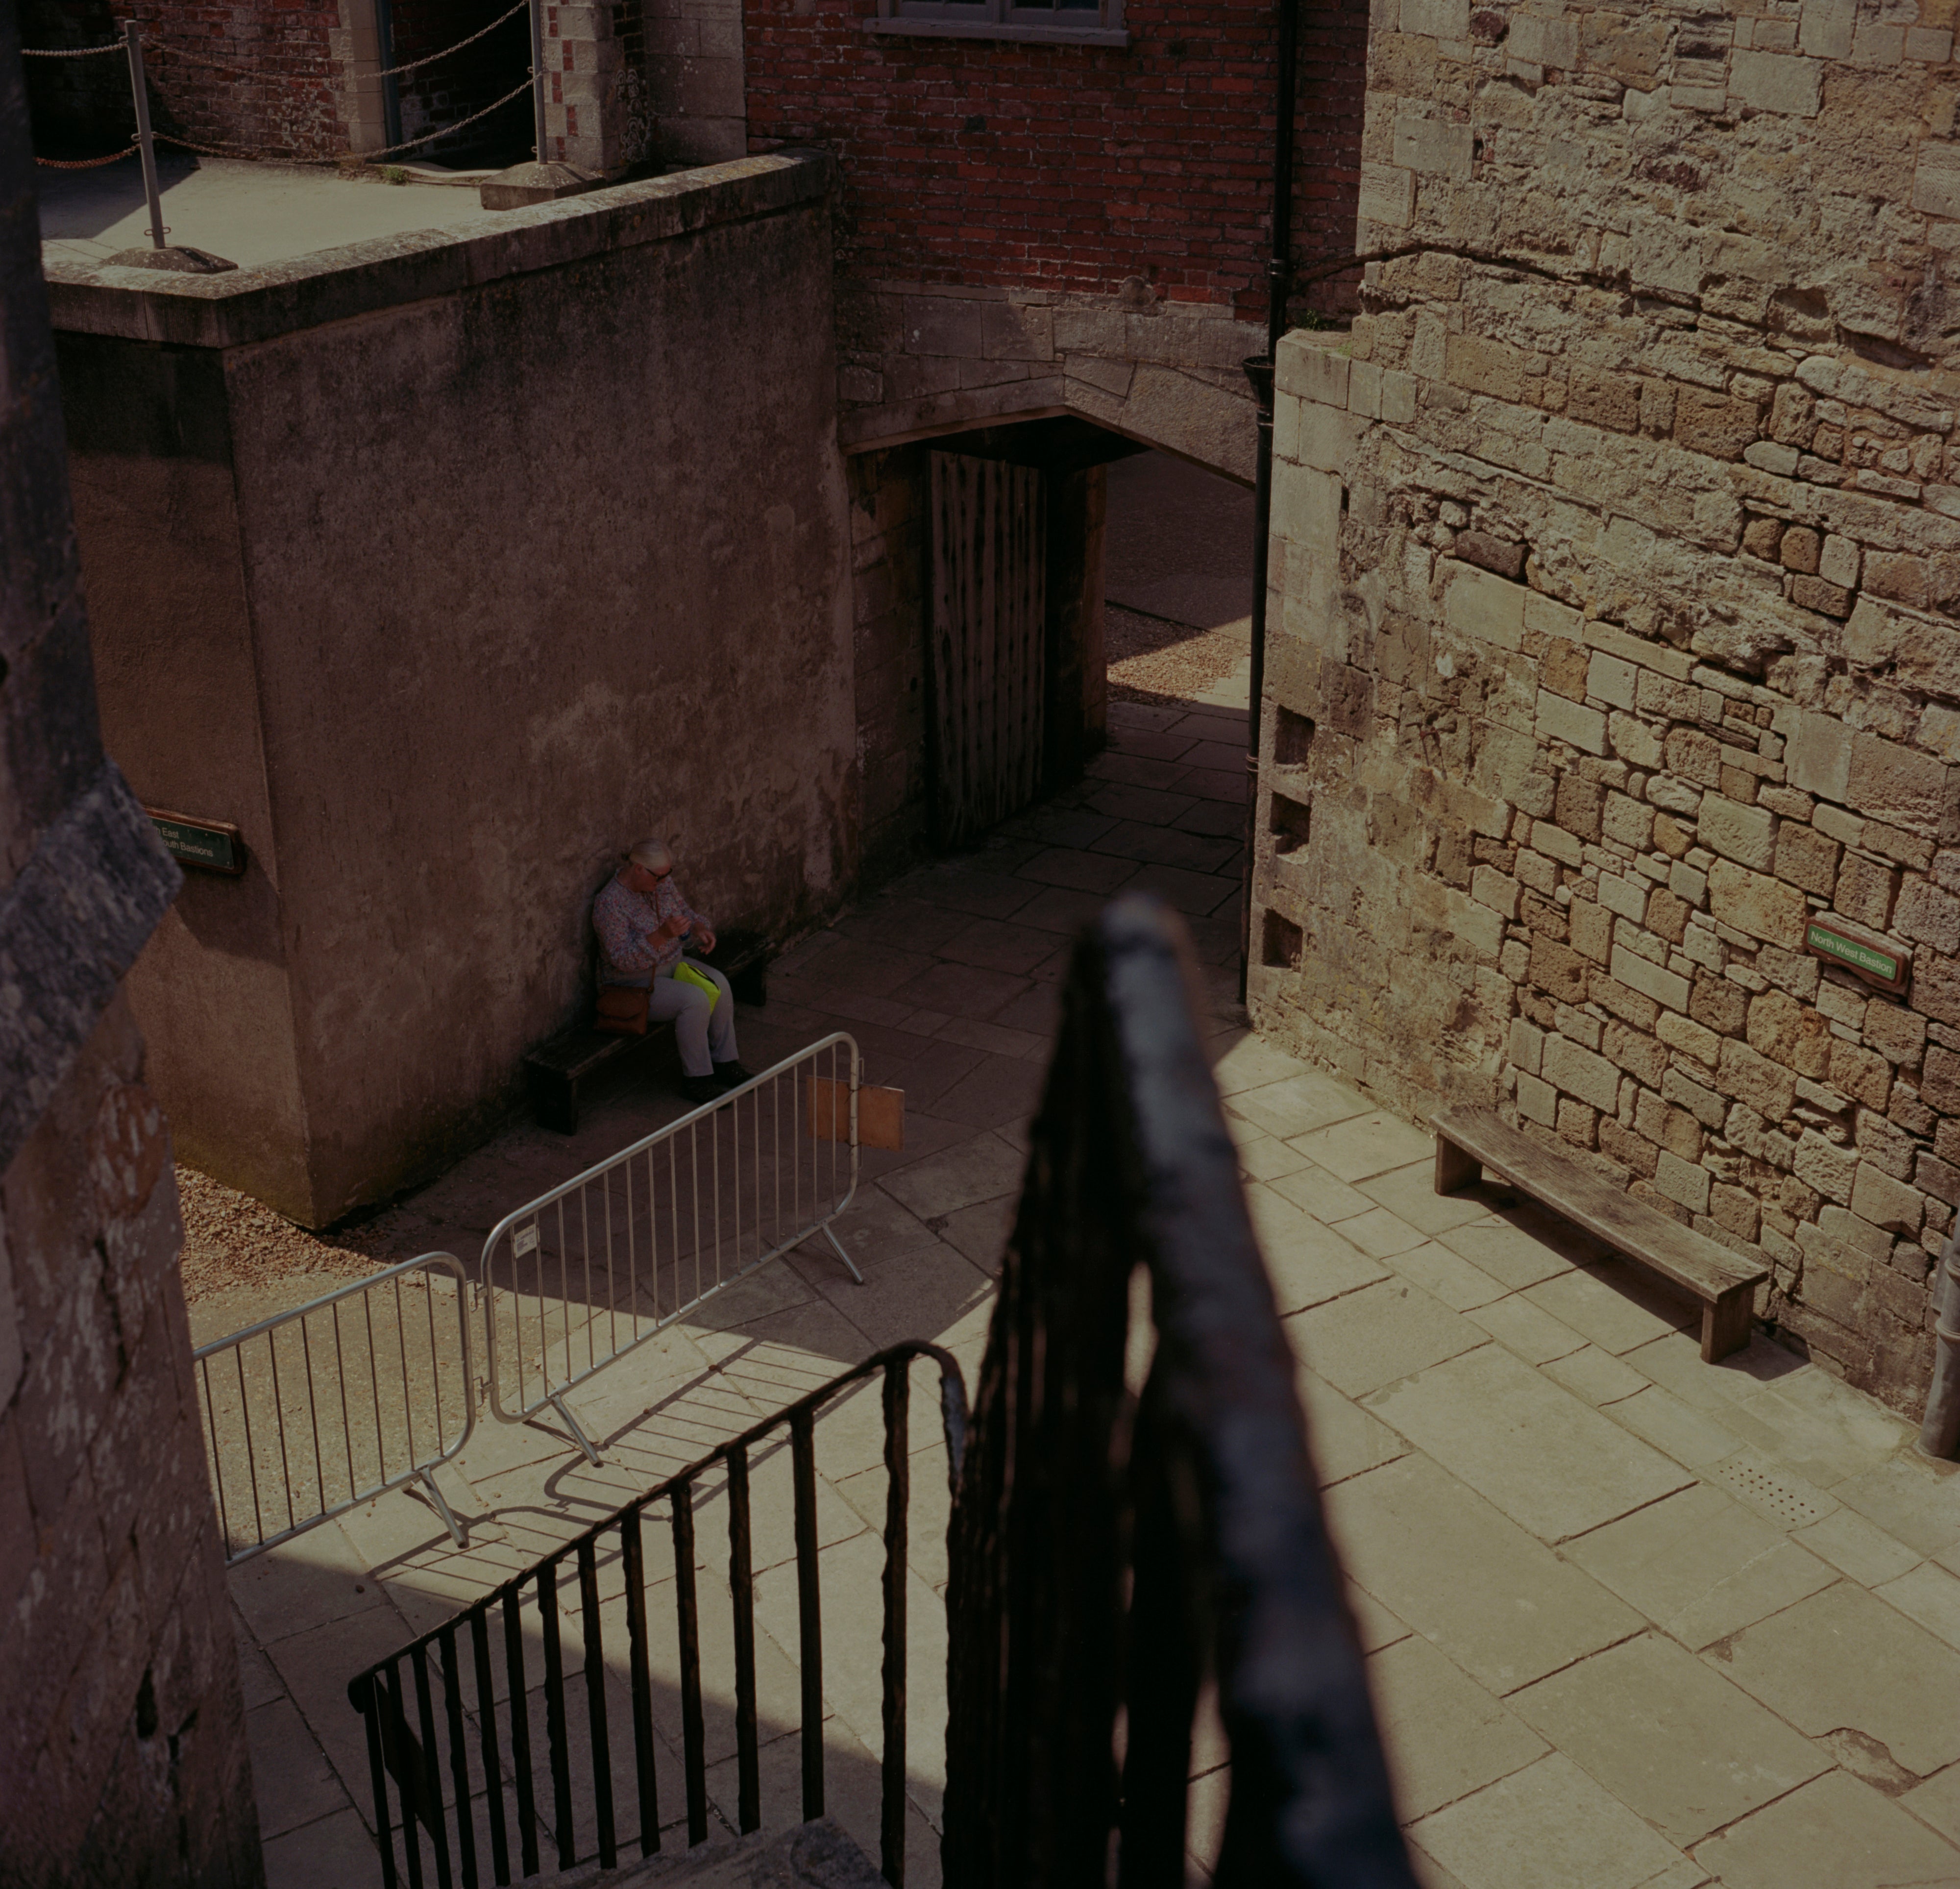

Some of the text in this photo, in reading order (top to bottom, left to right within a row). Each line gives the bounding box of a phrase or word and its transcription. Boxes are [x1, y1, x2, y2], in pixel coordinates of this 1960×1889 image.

[162, 827, 179, 838] East
[163, 839, 213, 857] outh Bastions
[1811, 931, 1892, 973] North West Bastion
